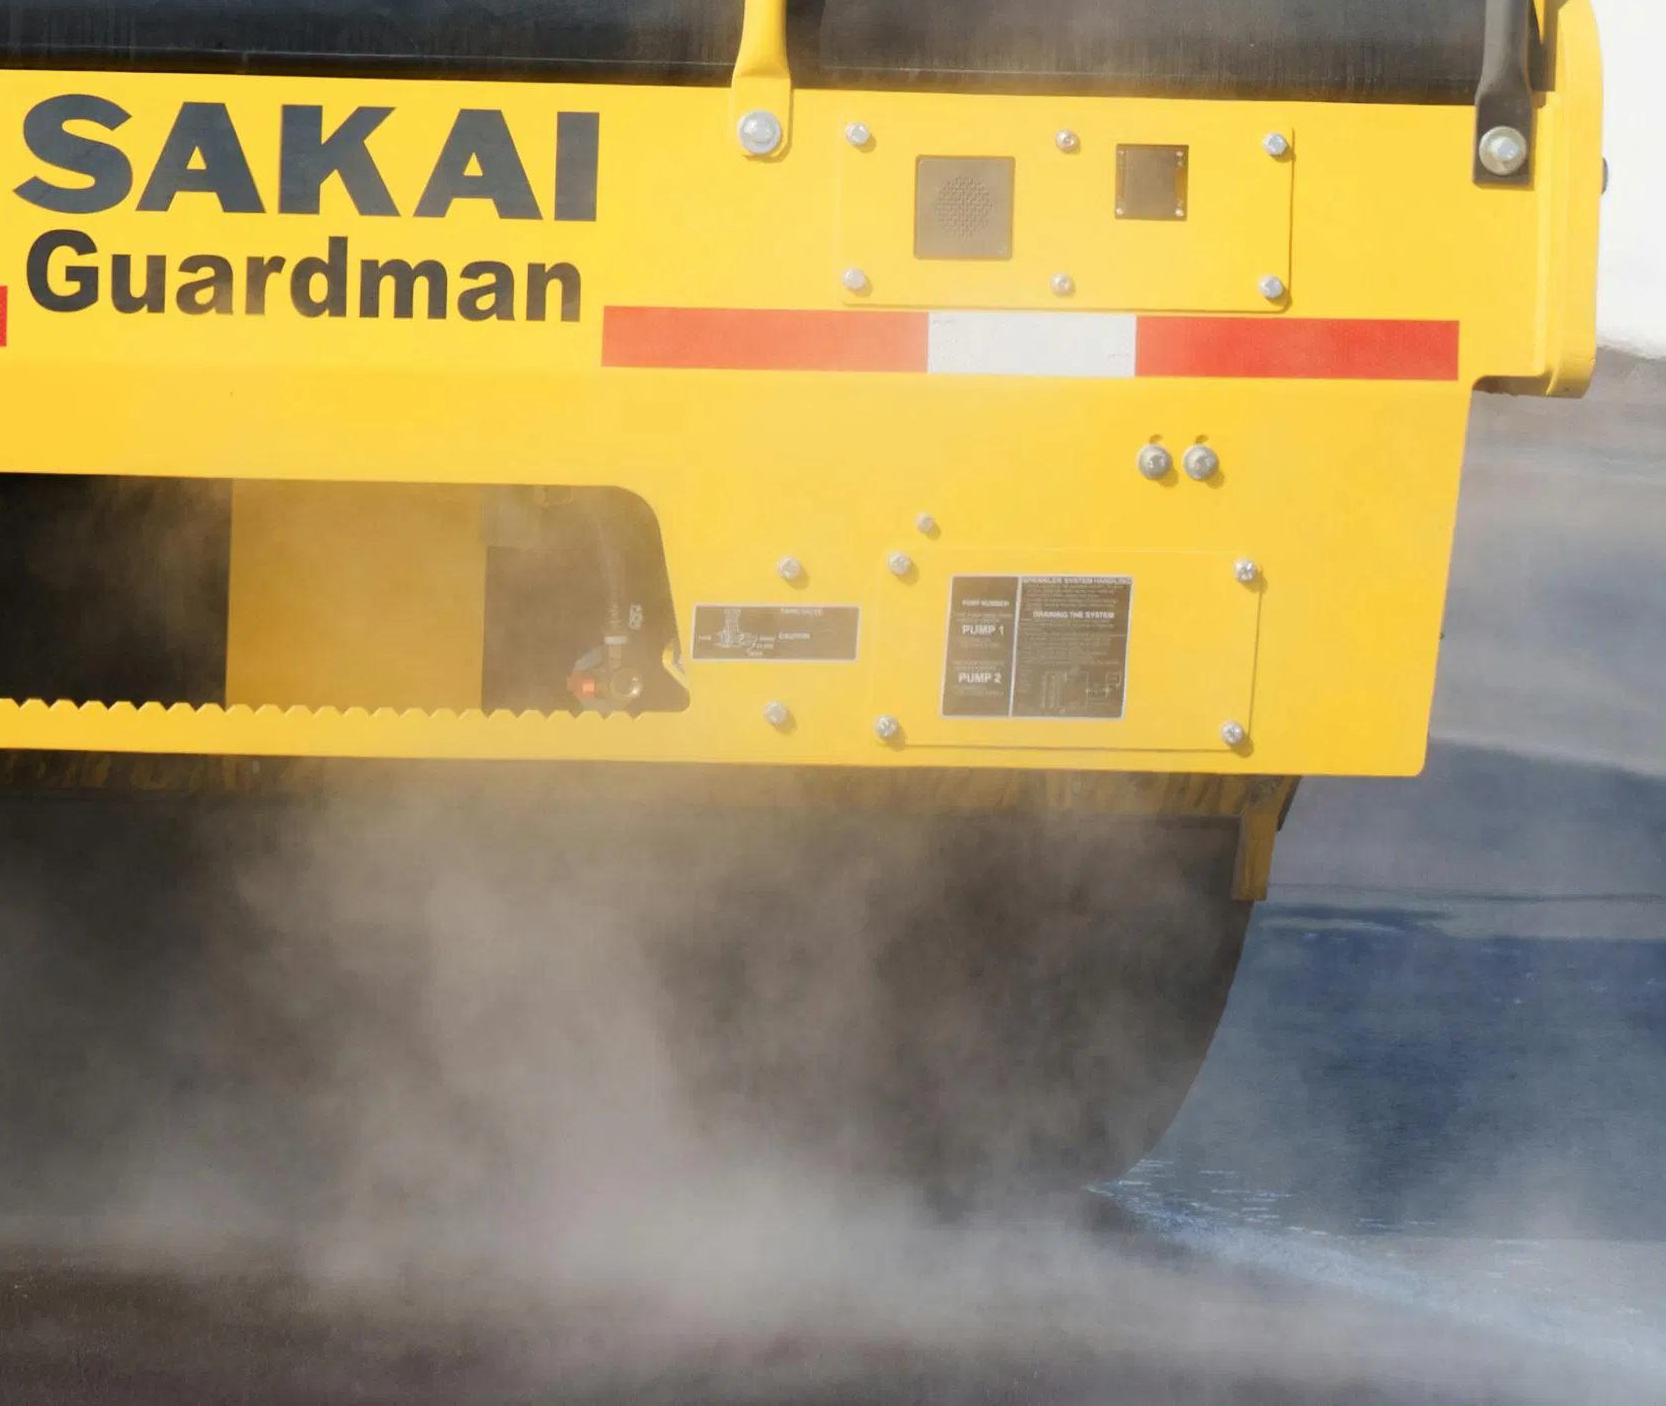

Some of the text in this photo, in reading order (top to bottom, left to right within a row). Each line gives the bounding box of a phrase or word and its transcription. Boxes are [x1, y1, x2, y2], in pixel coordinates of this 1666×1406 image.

[13, 94, 601, 223] SAKAI
[26, 229, 583, 323] Guardman
[1085, 611, 1115, 619] SYSTEM
[962, 625, 995, 635] PUMP
[958, 672, 1002, 684] PUMP 2
